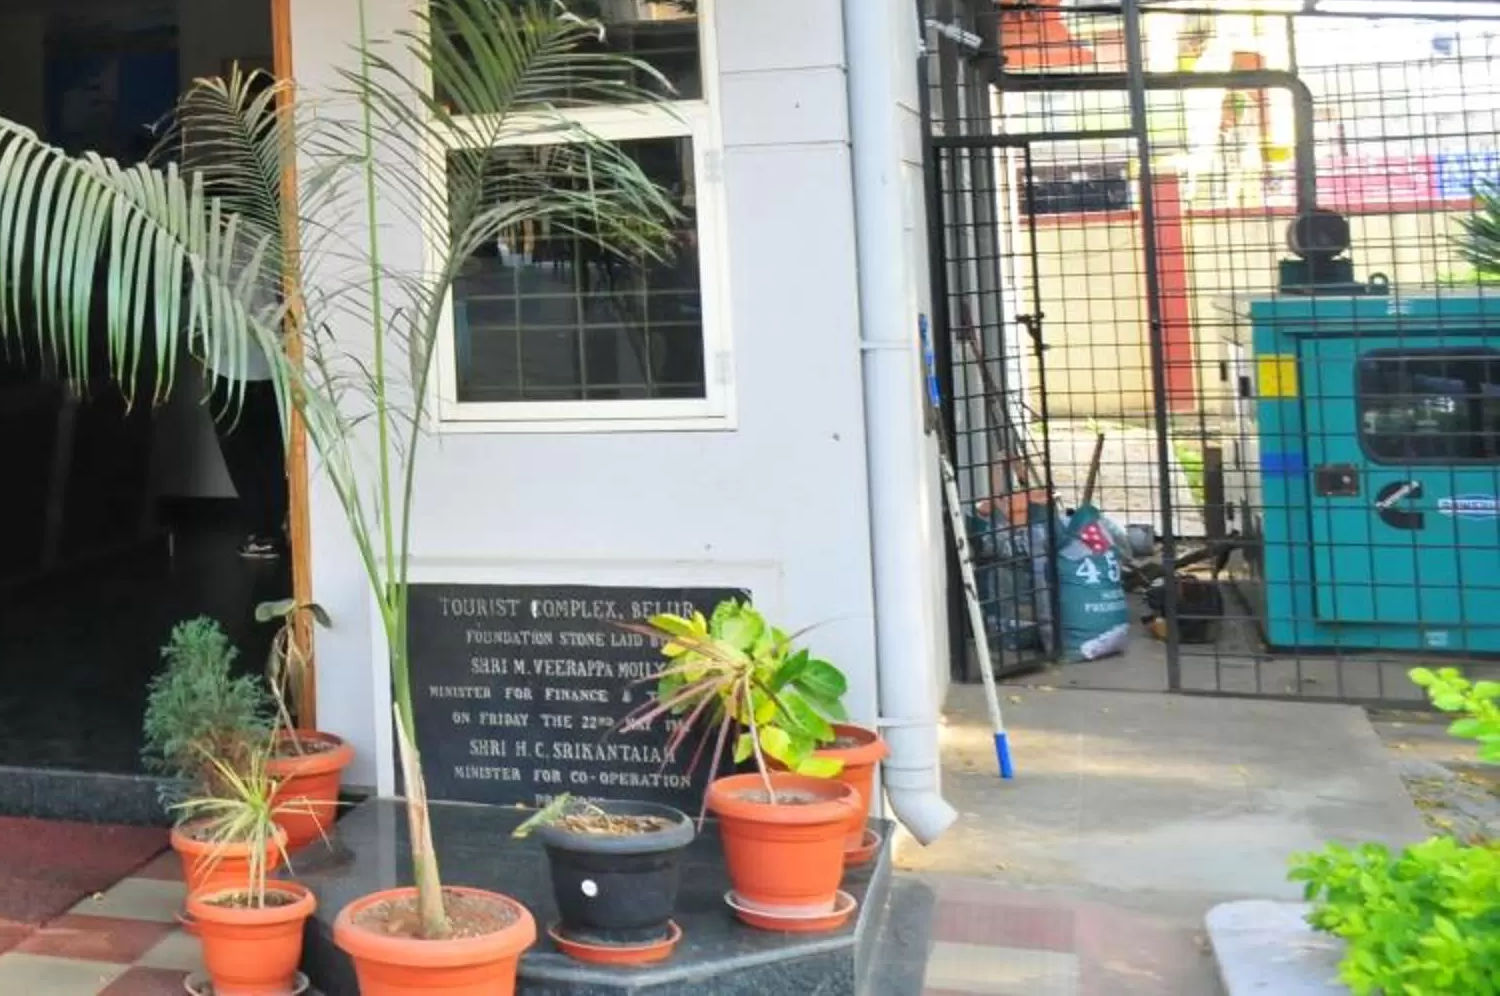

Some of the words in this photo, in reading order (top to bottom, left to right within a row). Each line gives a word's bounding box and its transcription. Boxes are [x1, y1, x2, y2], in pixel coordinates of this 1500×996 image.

[440, 598, 520, 617] TOURIST
[466, 629, 553, 645] FOUNDATION
[560, 631, 605, 647] STONE
[611, 632, 643, 647] LAID
[471, 657, 507, 674] SHRI
[429, 685, 492, 699] MINISTER
[504, 687, 533, 700] FOR
[544, 687, 609, 703] FINANCE
[452, 711, 471, 725] ON
[479, 711, 529, 727] FRIDAY
[540, 713, 573, 728] THE
[469, 739, 507, 757] SHRI
[454, 765, 521, 781] MINISTER
[533, 768, 562, 783] FOR
